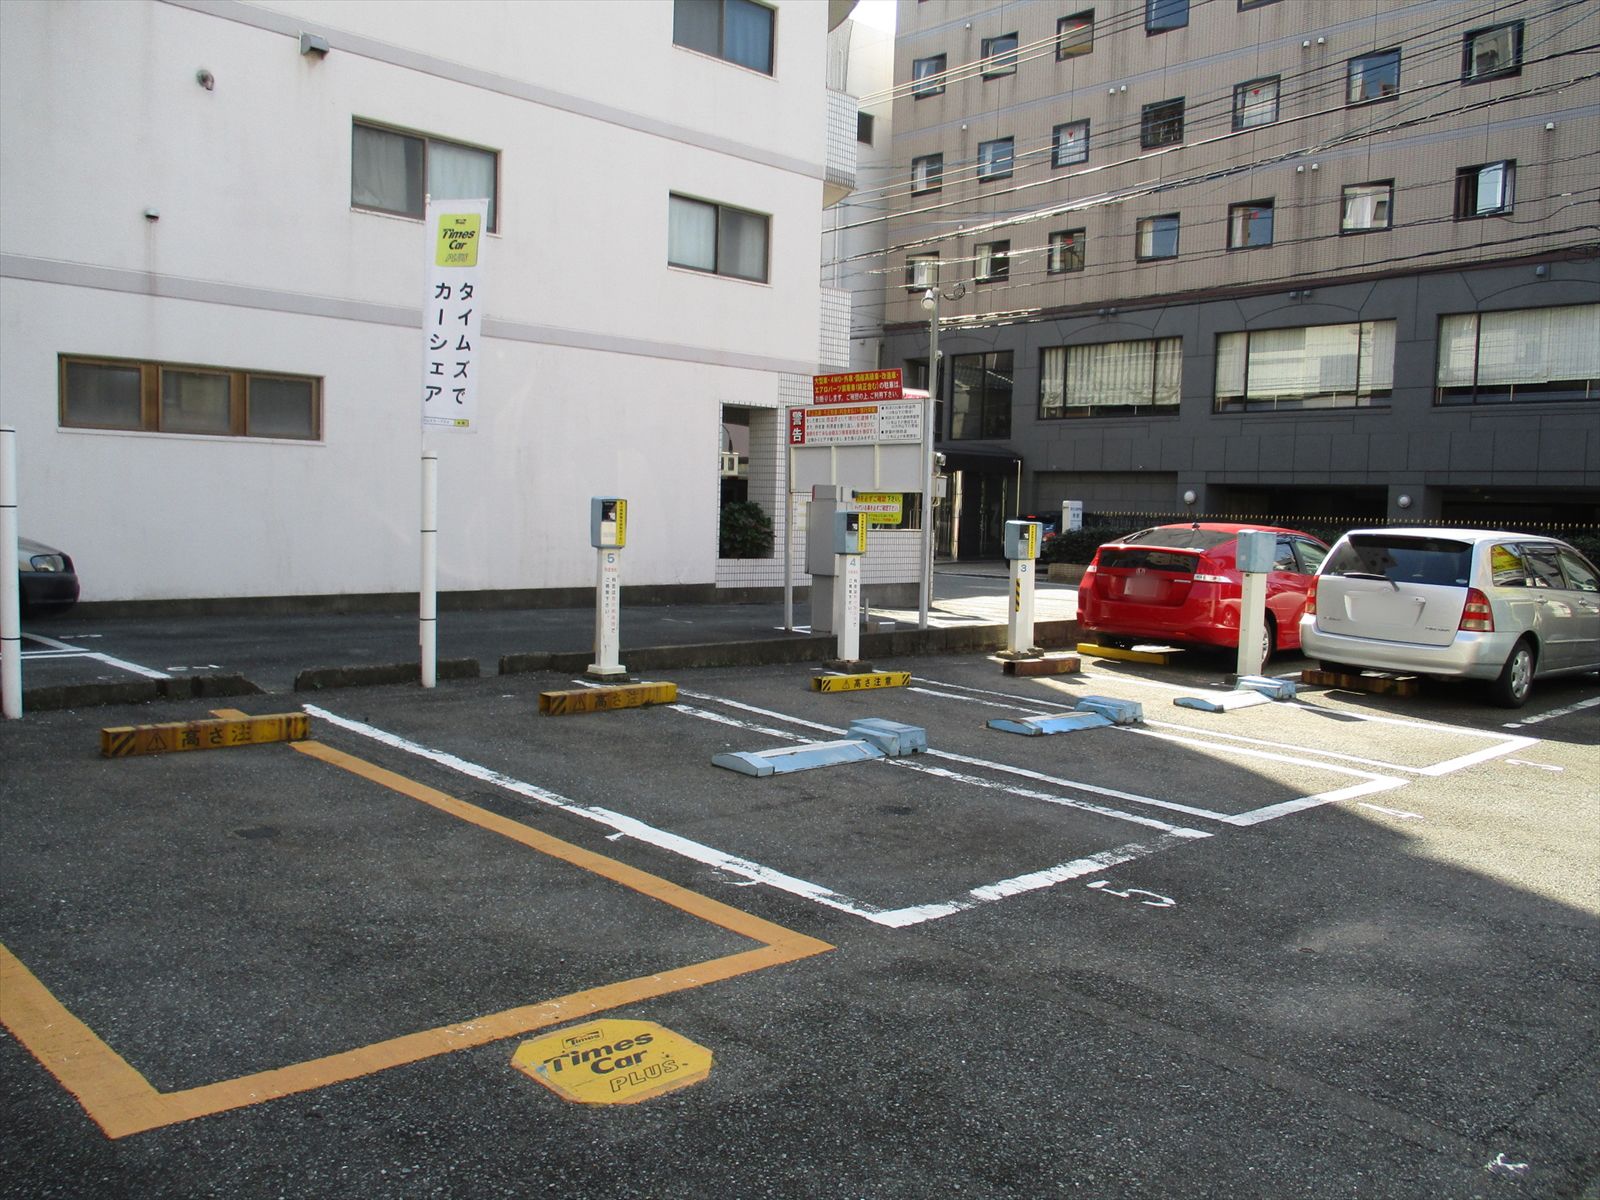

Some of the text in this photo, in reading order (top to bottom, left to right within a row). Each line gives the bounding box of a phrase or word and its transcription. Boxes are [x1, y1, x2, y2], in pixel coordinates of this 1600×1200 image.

[442, 228, 476, 239] Times
[449, 240, 467, 250] Car
[425, 282, 451, 402] カーシェア
[453, 282, 474, 405] タイムズで
[792, 411, 802, 441] 警告
[607, 553, 615, 563] 5
[850, 558, 856, 566] 4
[1020, 564, 1027, 573] 3
[853, 676, 892, 688] 高さ注意
[182, 723, 276, 748] 高さ注
[565, 1031, 600, 1046] Times
[543, 1033, 654, 1072] Times
[590, 1050, 647, 1074] Car
[609, 1059, 679, 1093] PLUS
